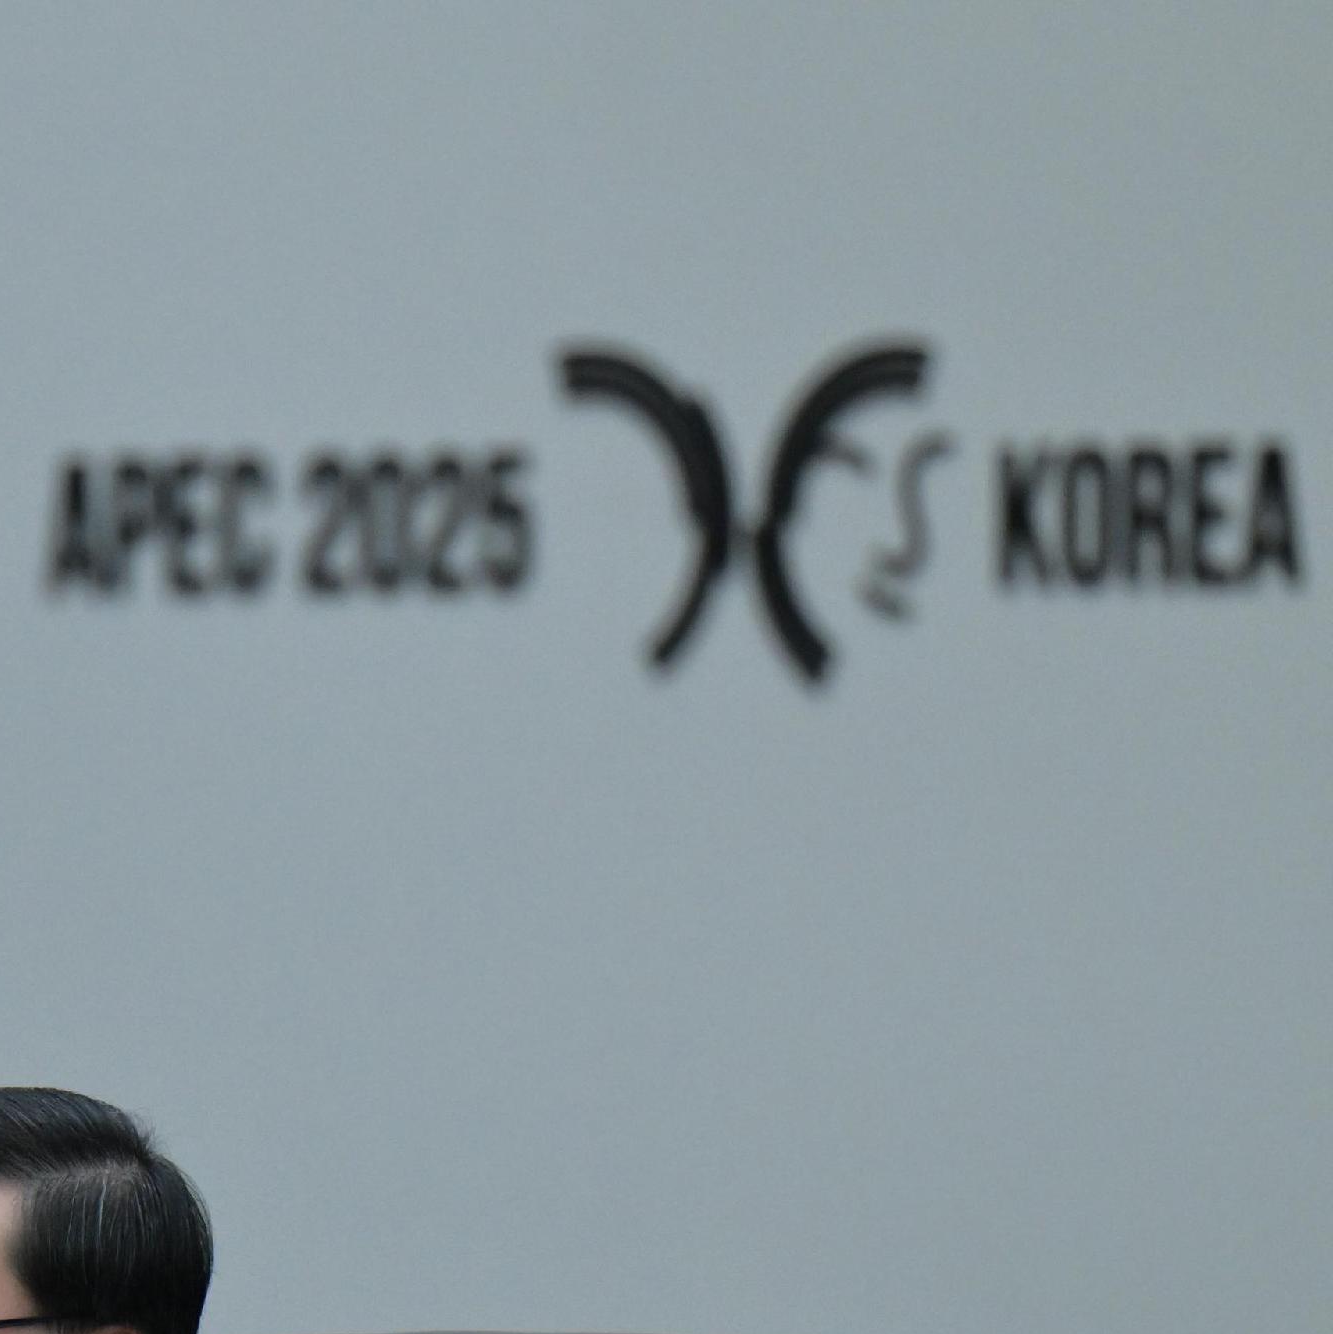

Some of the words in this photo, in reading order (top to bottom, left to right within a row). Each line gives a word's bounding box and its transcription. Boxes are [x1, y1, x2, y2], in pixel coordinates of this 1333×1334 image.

[48, 452, 271, 597] APEC
[301, 449, 533, 596] 2025
[996, 440, 1304, 592] KOREA
